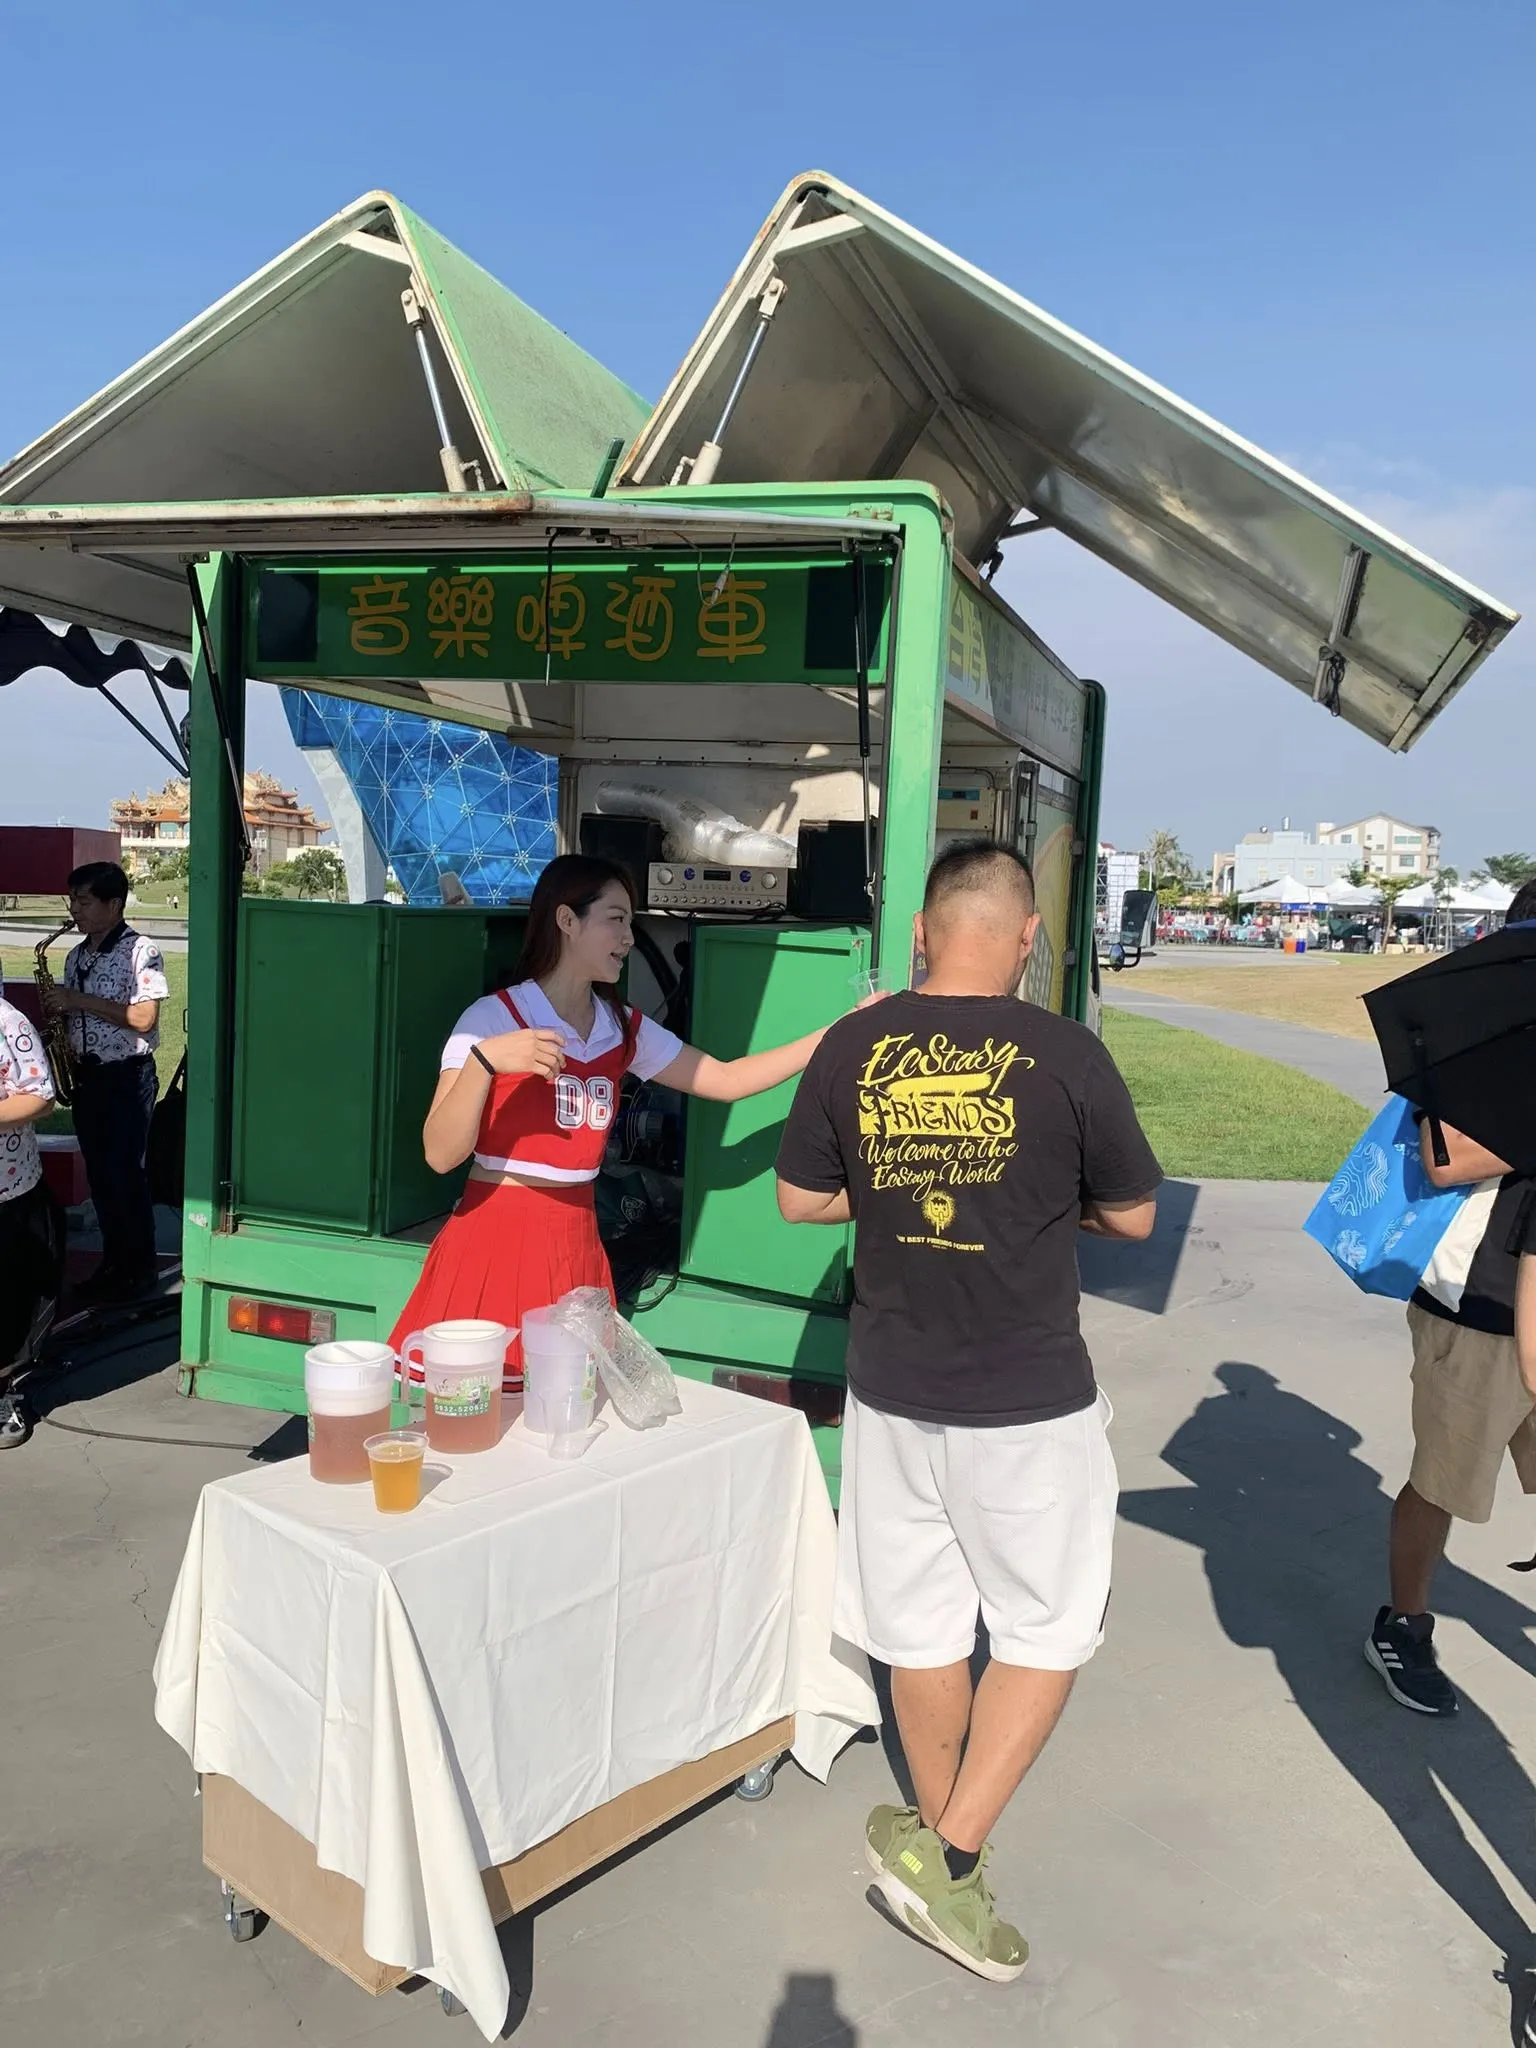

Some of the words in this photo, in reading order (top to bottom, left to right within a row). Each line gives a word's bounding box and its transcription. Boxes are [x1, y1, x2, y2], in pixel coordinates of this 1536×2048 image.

[346, 574, 767, 663] 音樂啤酒車
[555, 1073, 614, 1130] 08
[957, 1138, 977, 1160] to
[977, 1136, 1019, 1158] the
